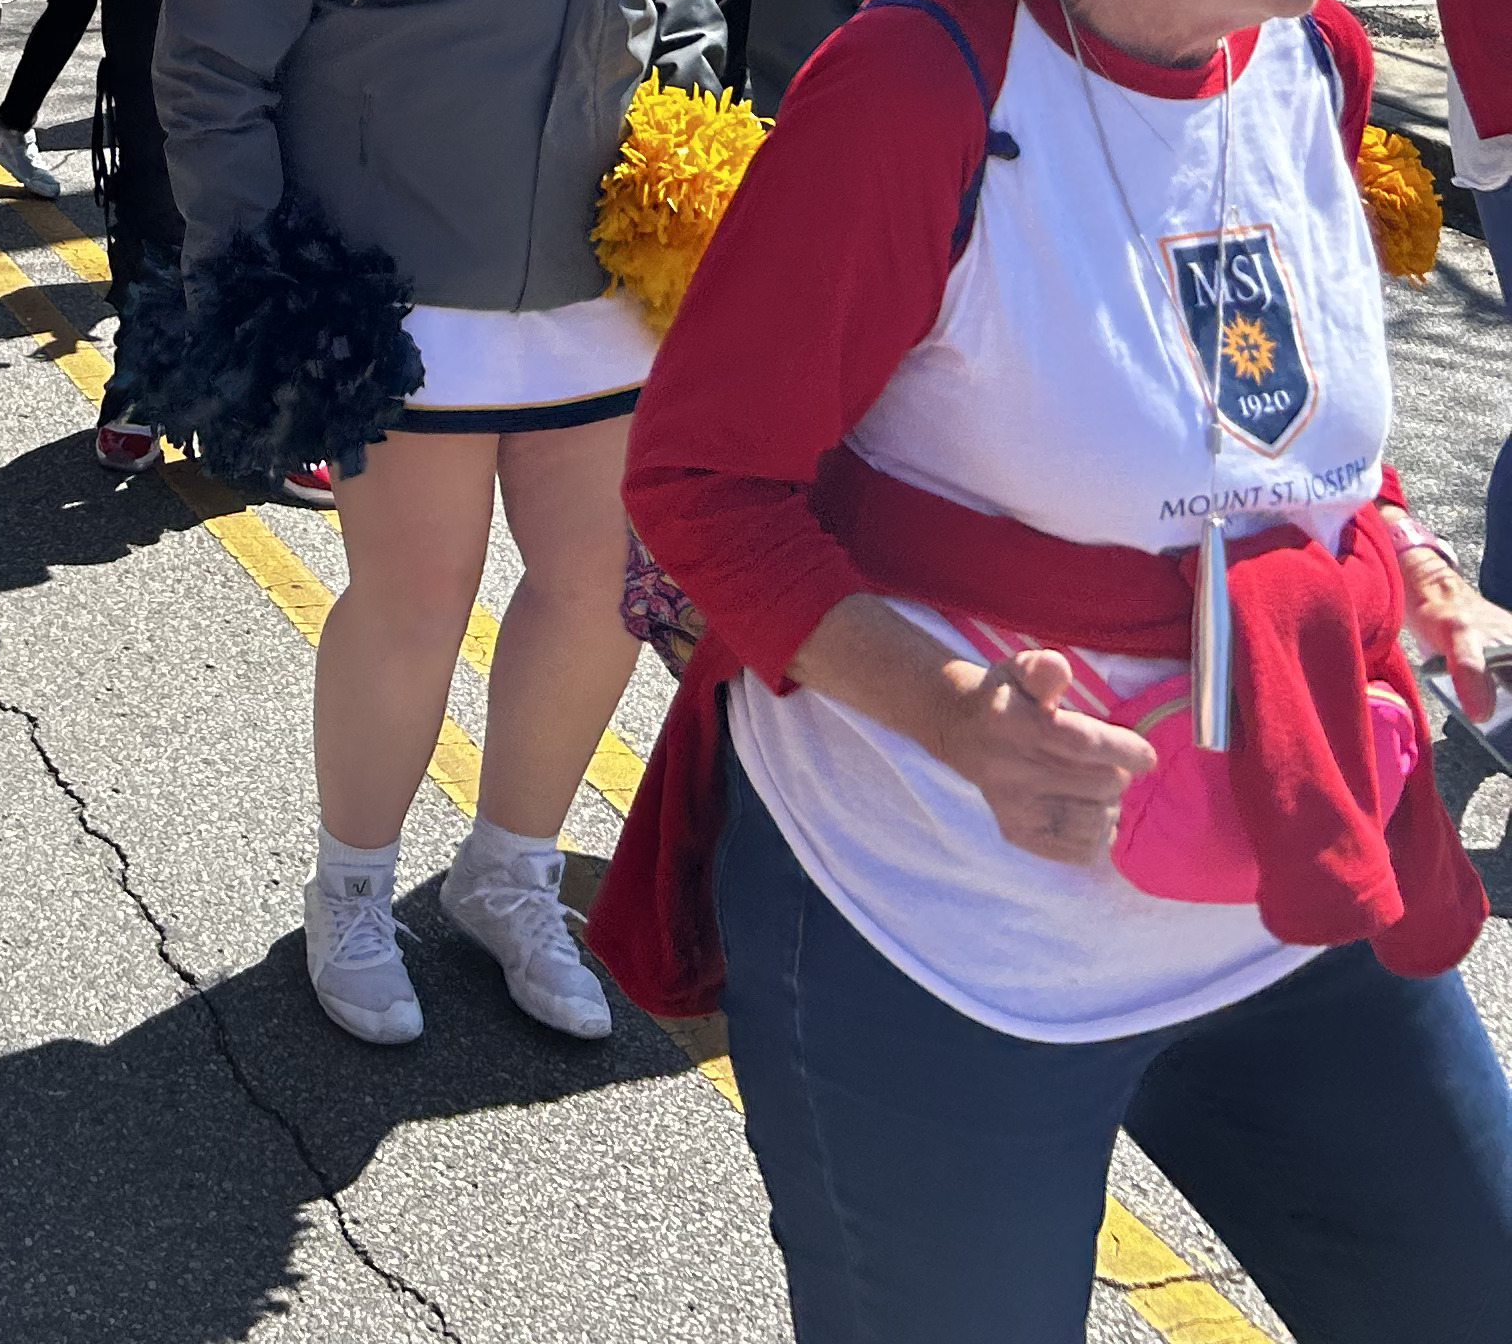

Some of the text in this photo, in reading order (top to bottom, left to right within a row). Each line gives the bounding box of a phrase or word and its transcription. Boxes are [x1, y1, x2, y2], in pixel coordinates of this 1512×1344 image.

[1187, 253, 1274, 311] MSJ
[1238, 390, 1291, 420] 1920
[1159, 486, 1263, 520] MOUNT
[1305, 457, 1368, 507] JOSEPH
